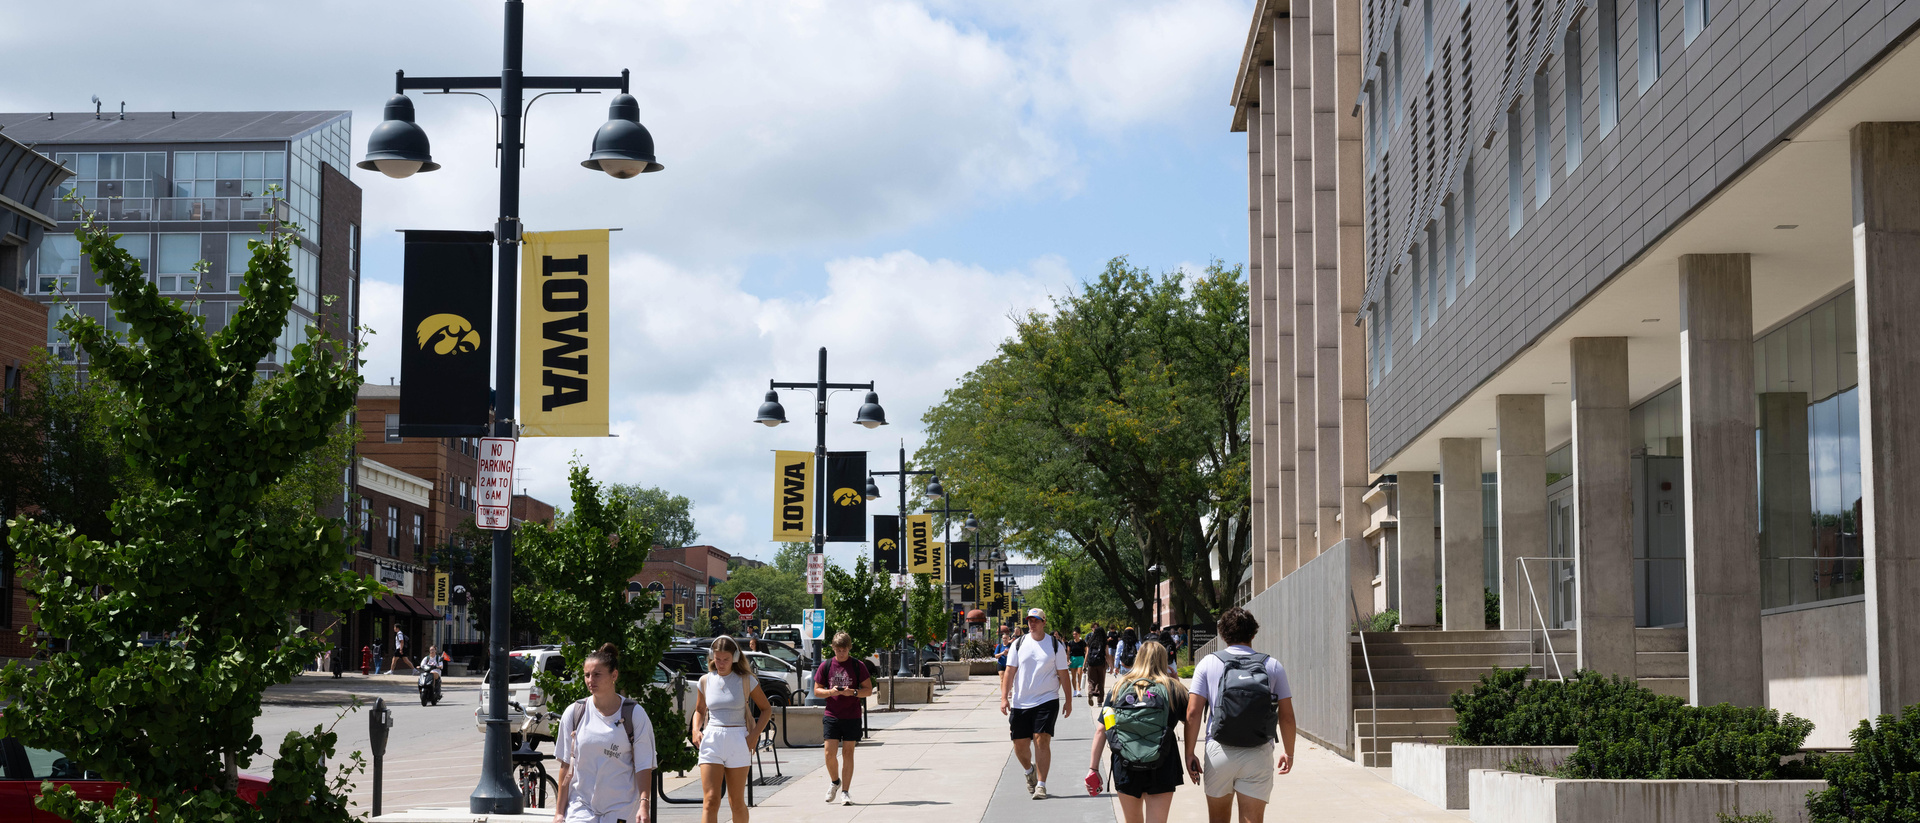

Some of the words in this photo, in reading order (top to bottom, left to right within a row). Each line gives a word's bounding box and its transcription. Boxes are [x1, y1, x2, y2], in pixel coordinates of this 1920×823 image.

[542, 254, 588, 412] IOWA
[491, 444, 502, 456] NO
[480, 460, 511, 472] PARKING
[480, 477, 486, 487] 2
[486, 477, 497, 487] AM
[499, 477, 508, 488] TO
[485, 490, 490, 500] 6
[491, 490, 501, 500] AM
[783, 462, 805, 531] IOWA
[480, 508, 506, 516] TOW-AWAY
[486, 517, 499, 525] ZONE
[912, 521, 928, 567] IOWA
[931, 547, 941, 580] IOWA
[438, 577, 446, 602] IOWA
[983, 573, 991, 598] IOWA
[735, 598, 756, 608] STOP
